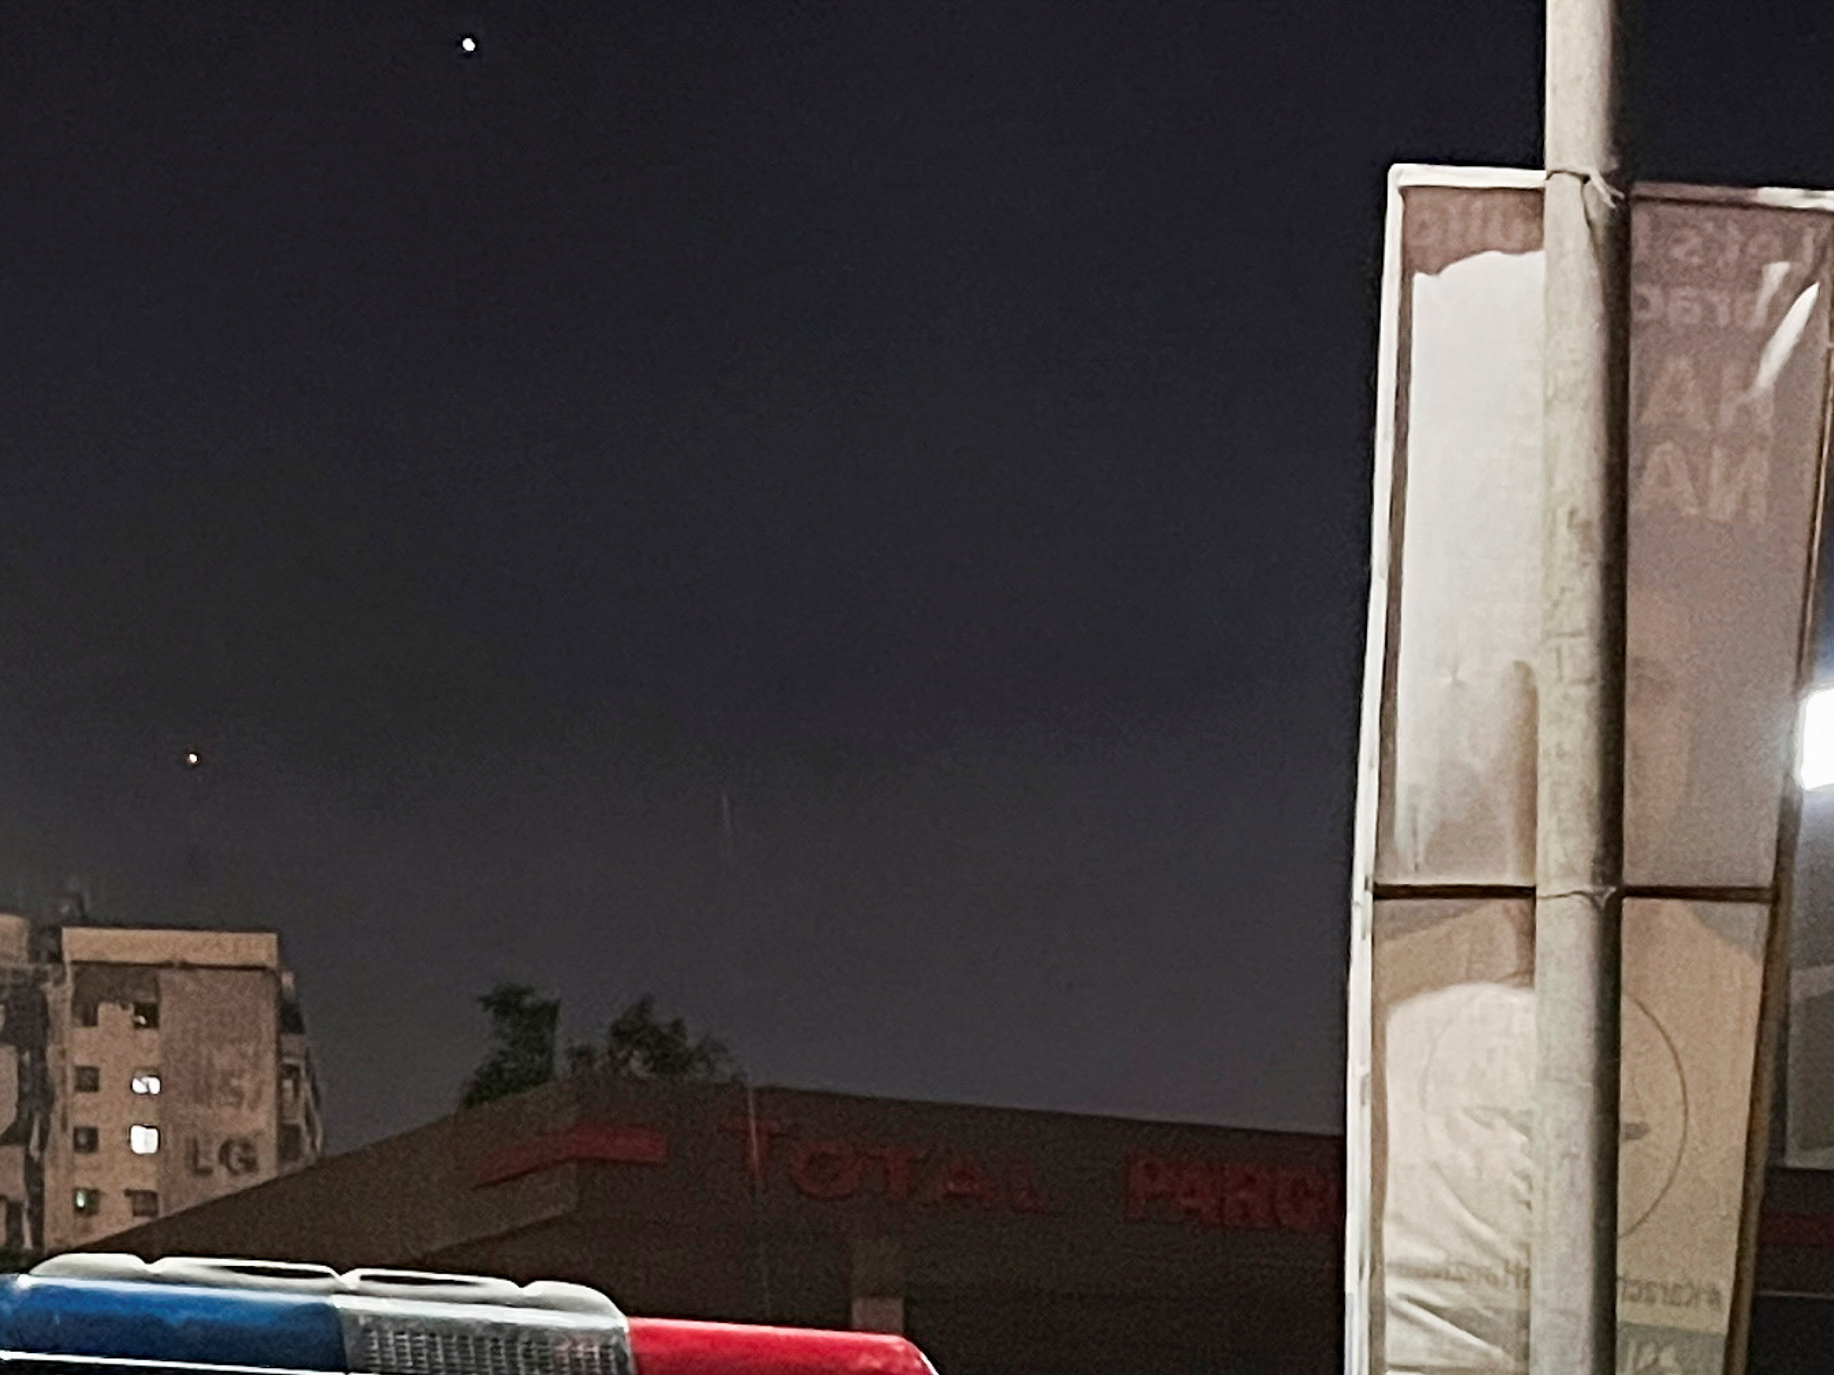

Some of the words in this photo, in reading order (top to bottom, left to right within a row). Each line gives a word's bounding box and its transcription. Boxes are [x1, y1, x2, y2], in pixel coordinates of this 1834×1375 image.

[186, 1135, 258, 1175] LG
[724, 1114, 1051, 1214] TOTAL
[1123, 1148, 1342, 1230] PARC
